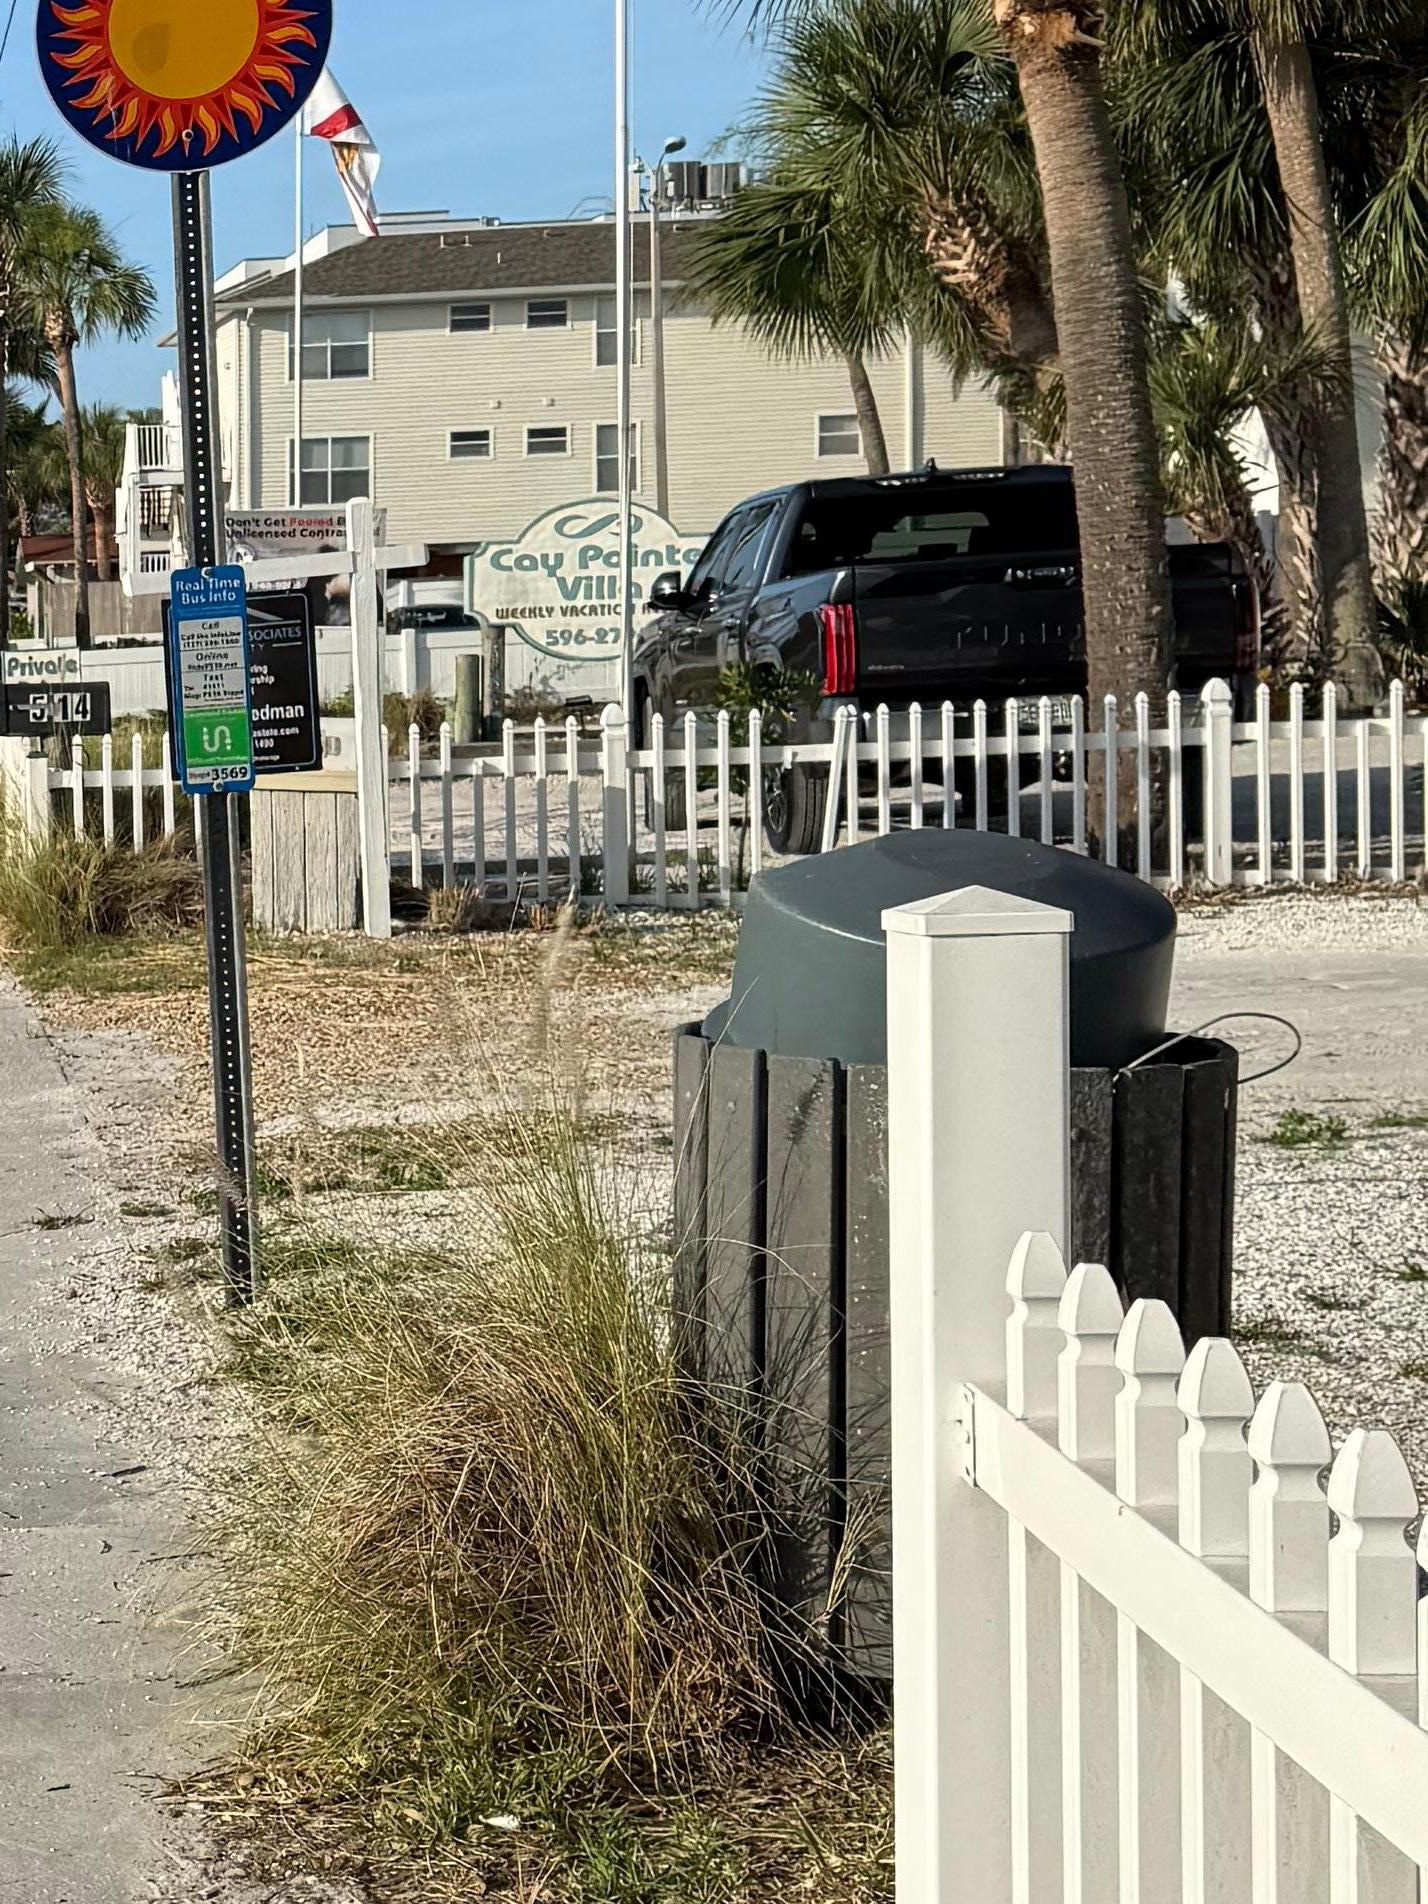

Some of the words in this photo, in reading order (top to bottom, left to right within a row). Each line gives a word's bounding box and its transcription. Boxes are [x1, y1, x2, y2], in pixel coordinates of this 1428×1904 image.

[226, 517, 261, 528] Don't
[264, 516, 286, 527] Get
[226, 529, 296, 539] Unlicensed
[299, 528, 347, 539] Contra
[490, 548, 564, 578] Cay
[176, 578, 204, 592] Real
[209, 578, 241, 590] Time
[182, 593, 206, 604] Bus
[209, 591, 236, 602] Info
[495, 606, 555, 620] WEEKLY
[559, 603, 636, 618] VACATIO
[248, 626, 302, 641] SOCIATES
[546, 627, 622, 646] 596-27
[7, 656, 79, 677] Private
[32, 694, 89, 721] 514
[251, 703, 305, 721] odman
[211, 766, 248, 781] 3569
